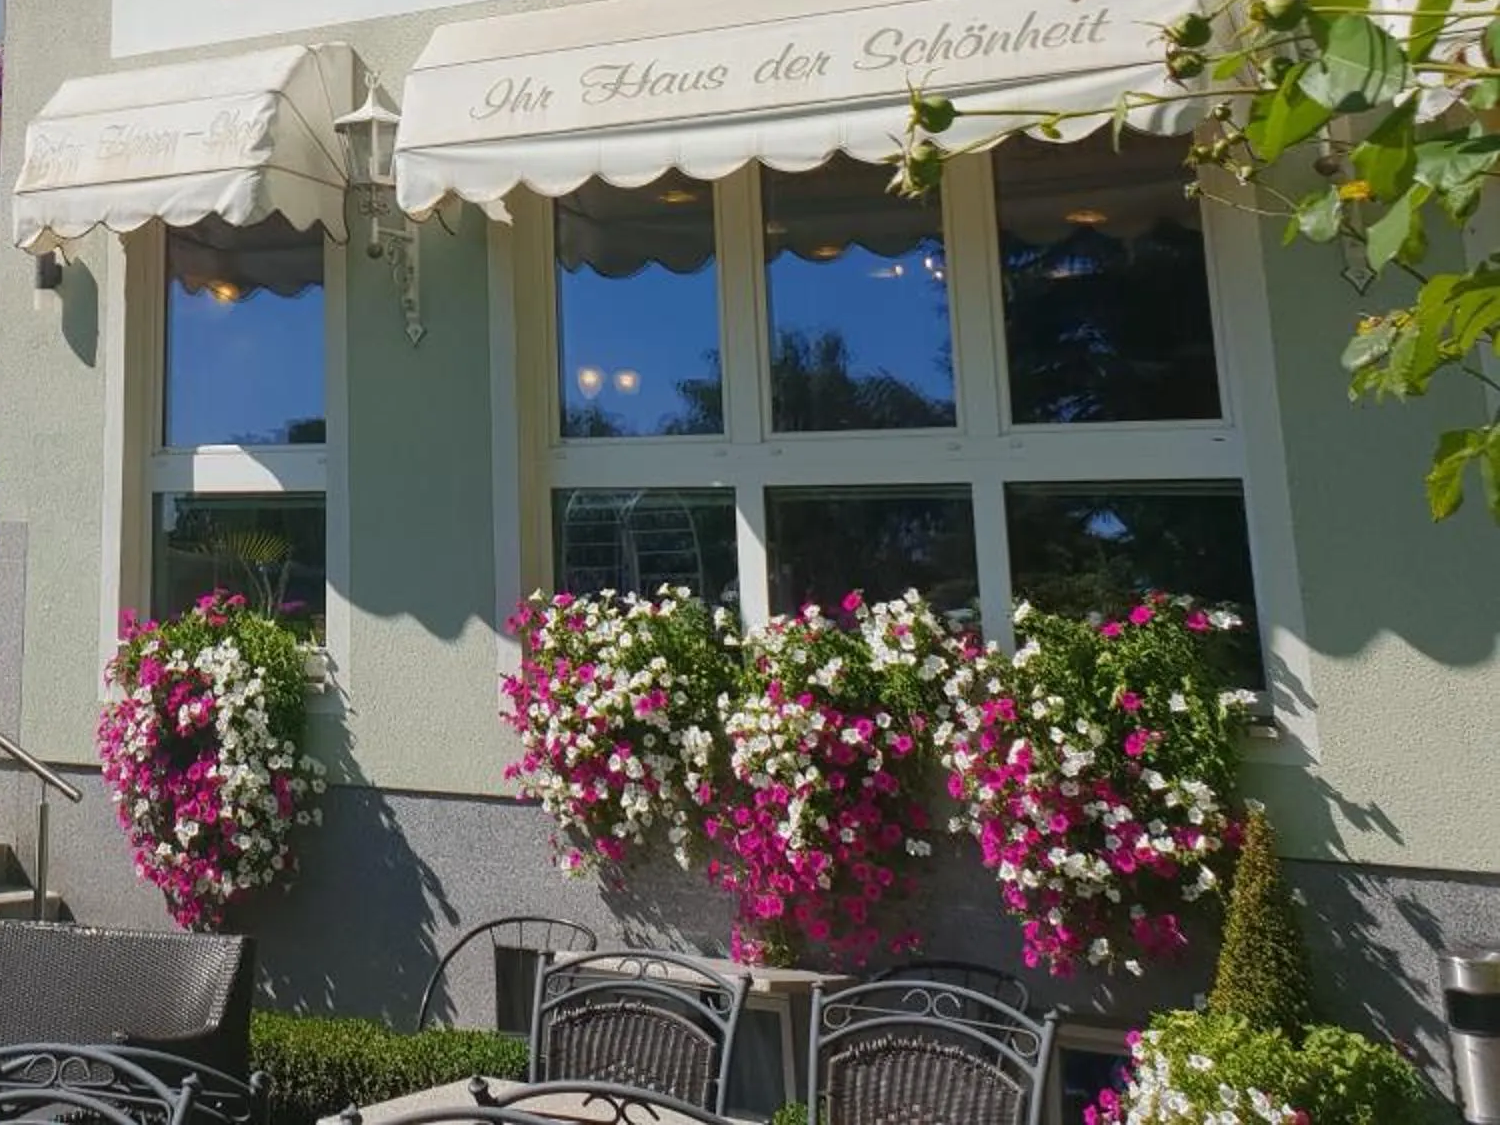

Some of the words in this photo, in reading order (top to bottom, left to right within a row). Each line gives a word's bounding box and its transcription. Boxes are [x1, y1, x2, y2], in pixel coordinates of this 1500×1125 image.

[469, 76, 555, 121] Ihr
[580, 59, 729, 106] Haus
[753, 42, 832, 85] der
[853, 7, 1110, 73] Schönheit
